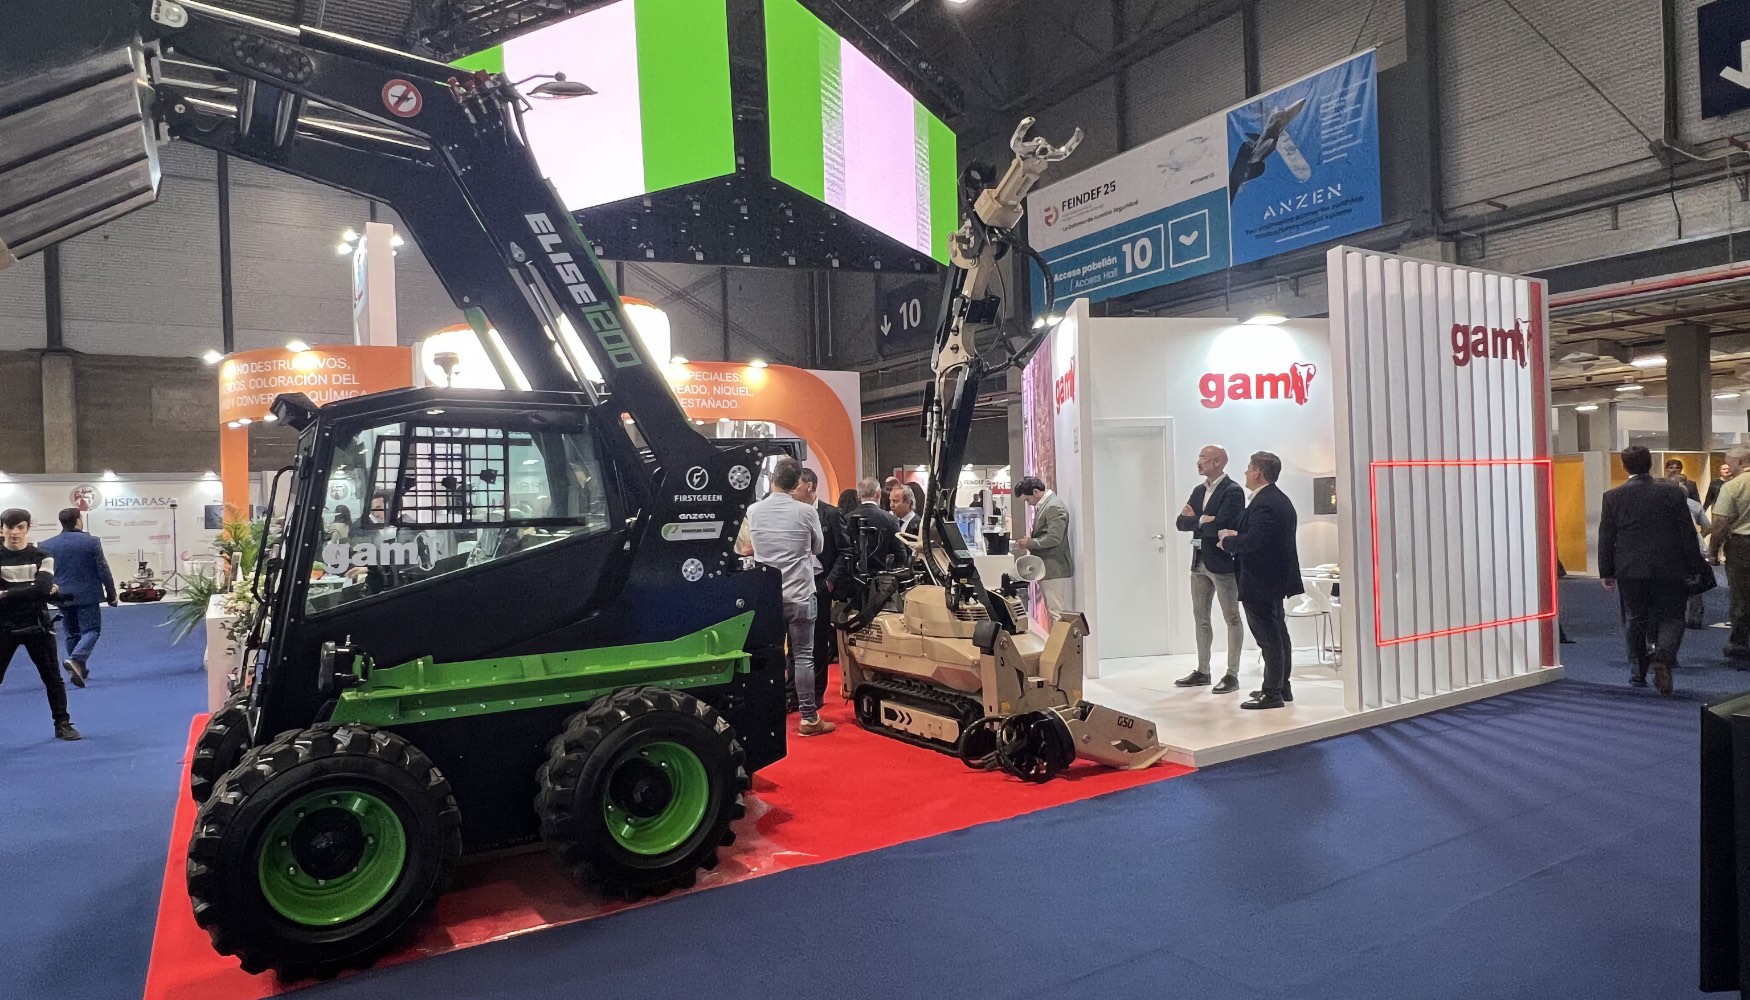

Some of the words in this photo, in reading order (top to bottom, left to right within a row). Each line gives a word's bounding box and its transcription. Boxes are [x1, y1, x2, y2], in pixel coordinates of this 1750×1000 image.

[1062, 186, 1102, 212] FEINDEF
[1103, 180, 1116, 196] 25
[1263, 183, 1341, 220] ANZEN
[525, 212, 598, 305] ELISE
[1122, 237, 1153, 274] 10
[1053, 268, 1082, 283] Acceso
[899, 298, 921, 330] 10
[582, 301, 643, 369] 1200
[1451, 322, 1520, 367] gam
[250, 372, 328, 389] COLORACIÓN
[332, 374, 360, 385] DEL
[1055, 370, 1073, 416] gam
[1199, 372, 1292, 409] gam
[674, 494, 723, 502] FIRSTGREEN
[321, 540, 418, 575] gam
